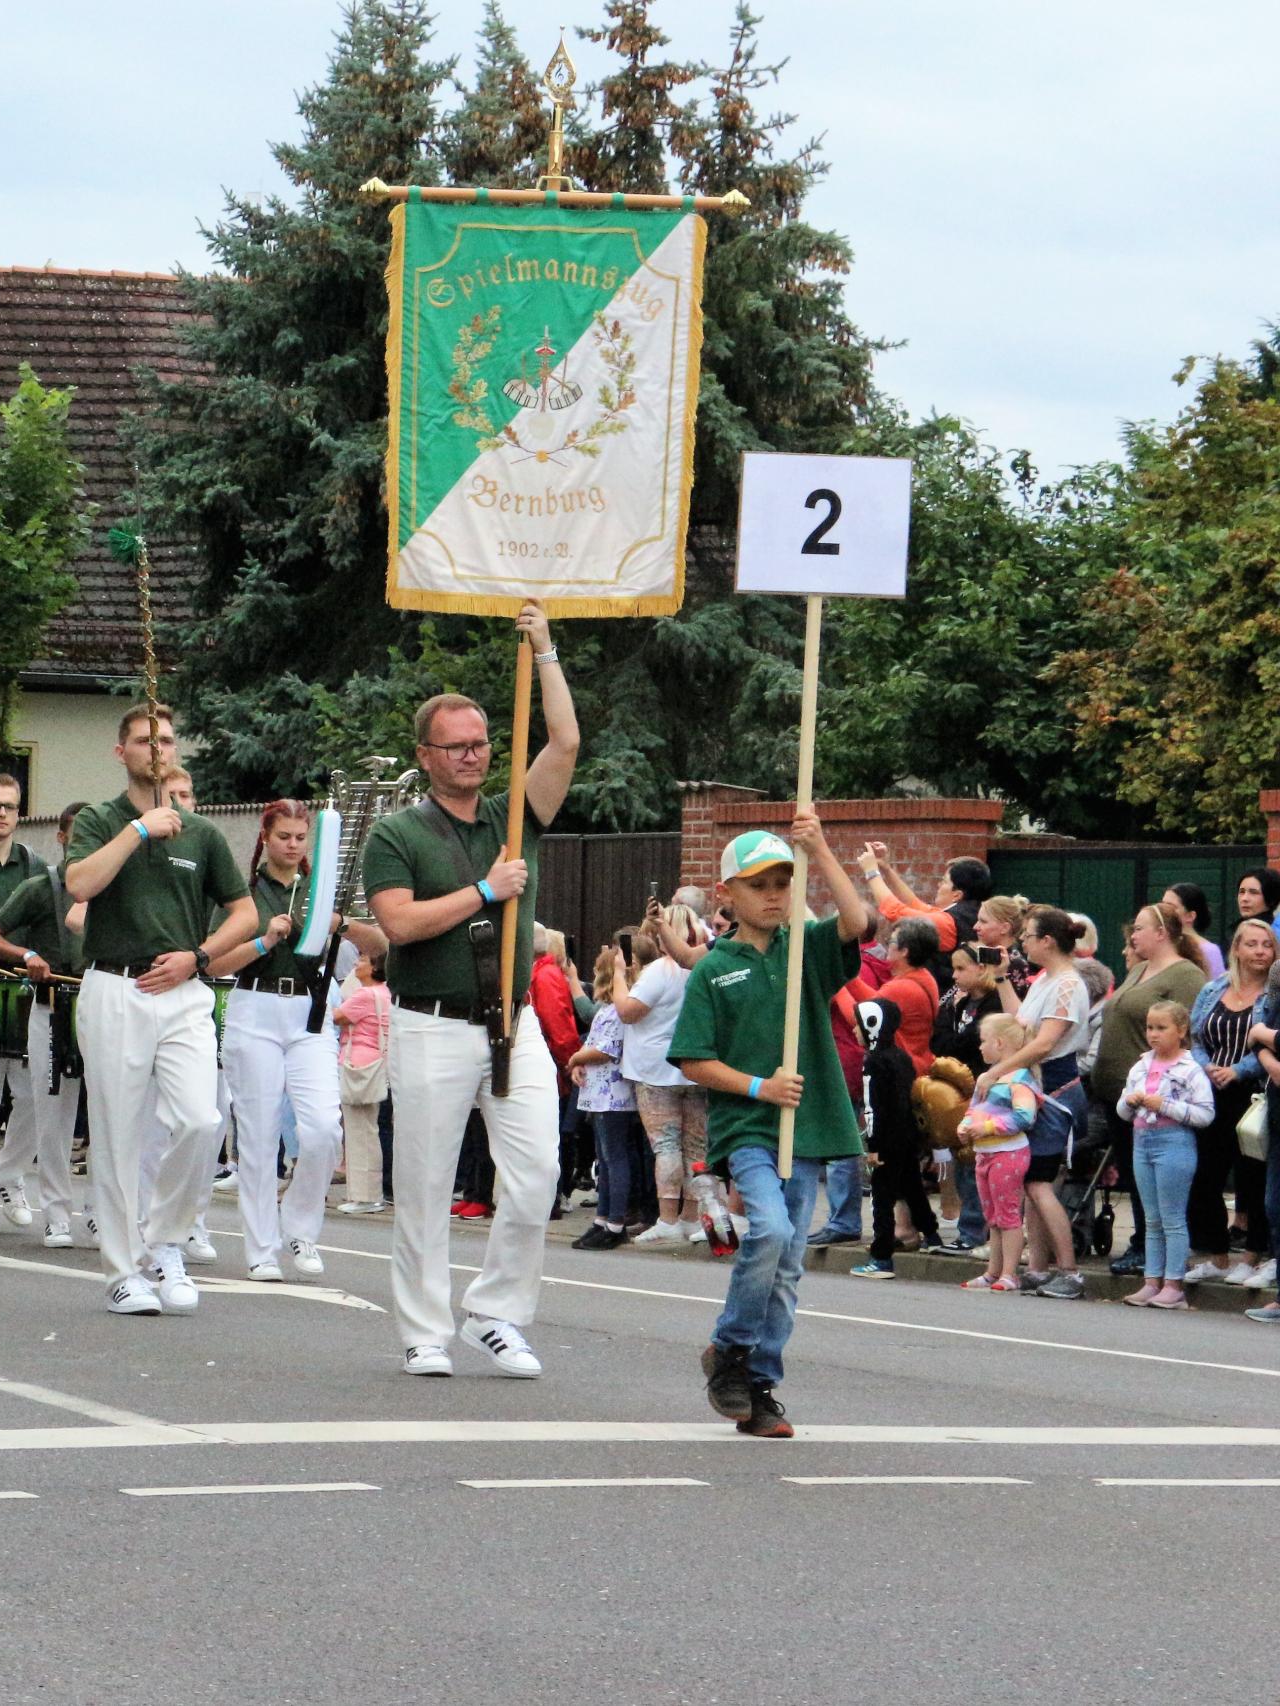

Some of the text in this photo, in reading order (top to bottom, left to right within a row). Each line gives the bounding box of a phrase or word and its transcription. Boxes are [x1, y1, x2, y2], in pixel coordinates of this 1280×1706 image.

[426, 253, 665, 322] Spielmannszug
[468, 475, 606, 517] Bernburg
[801, 488, 842, 555] 2
[497, 541, 539, 558] 1902
